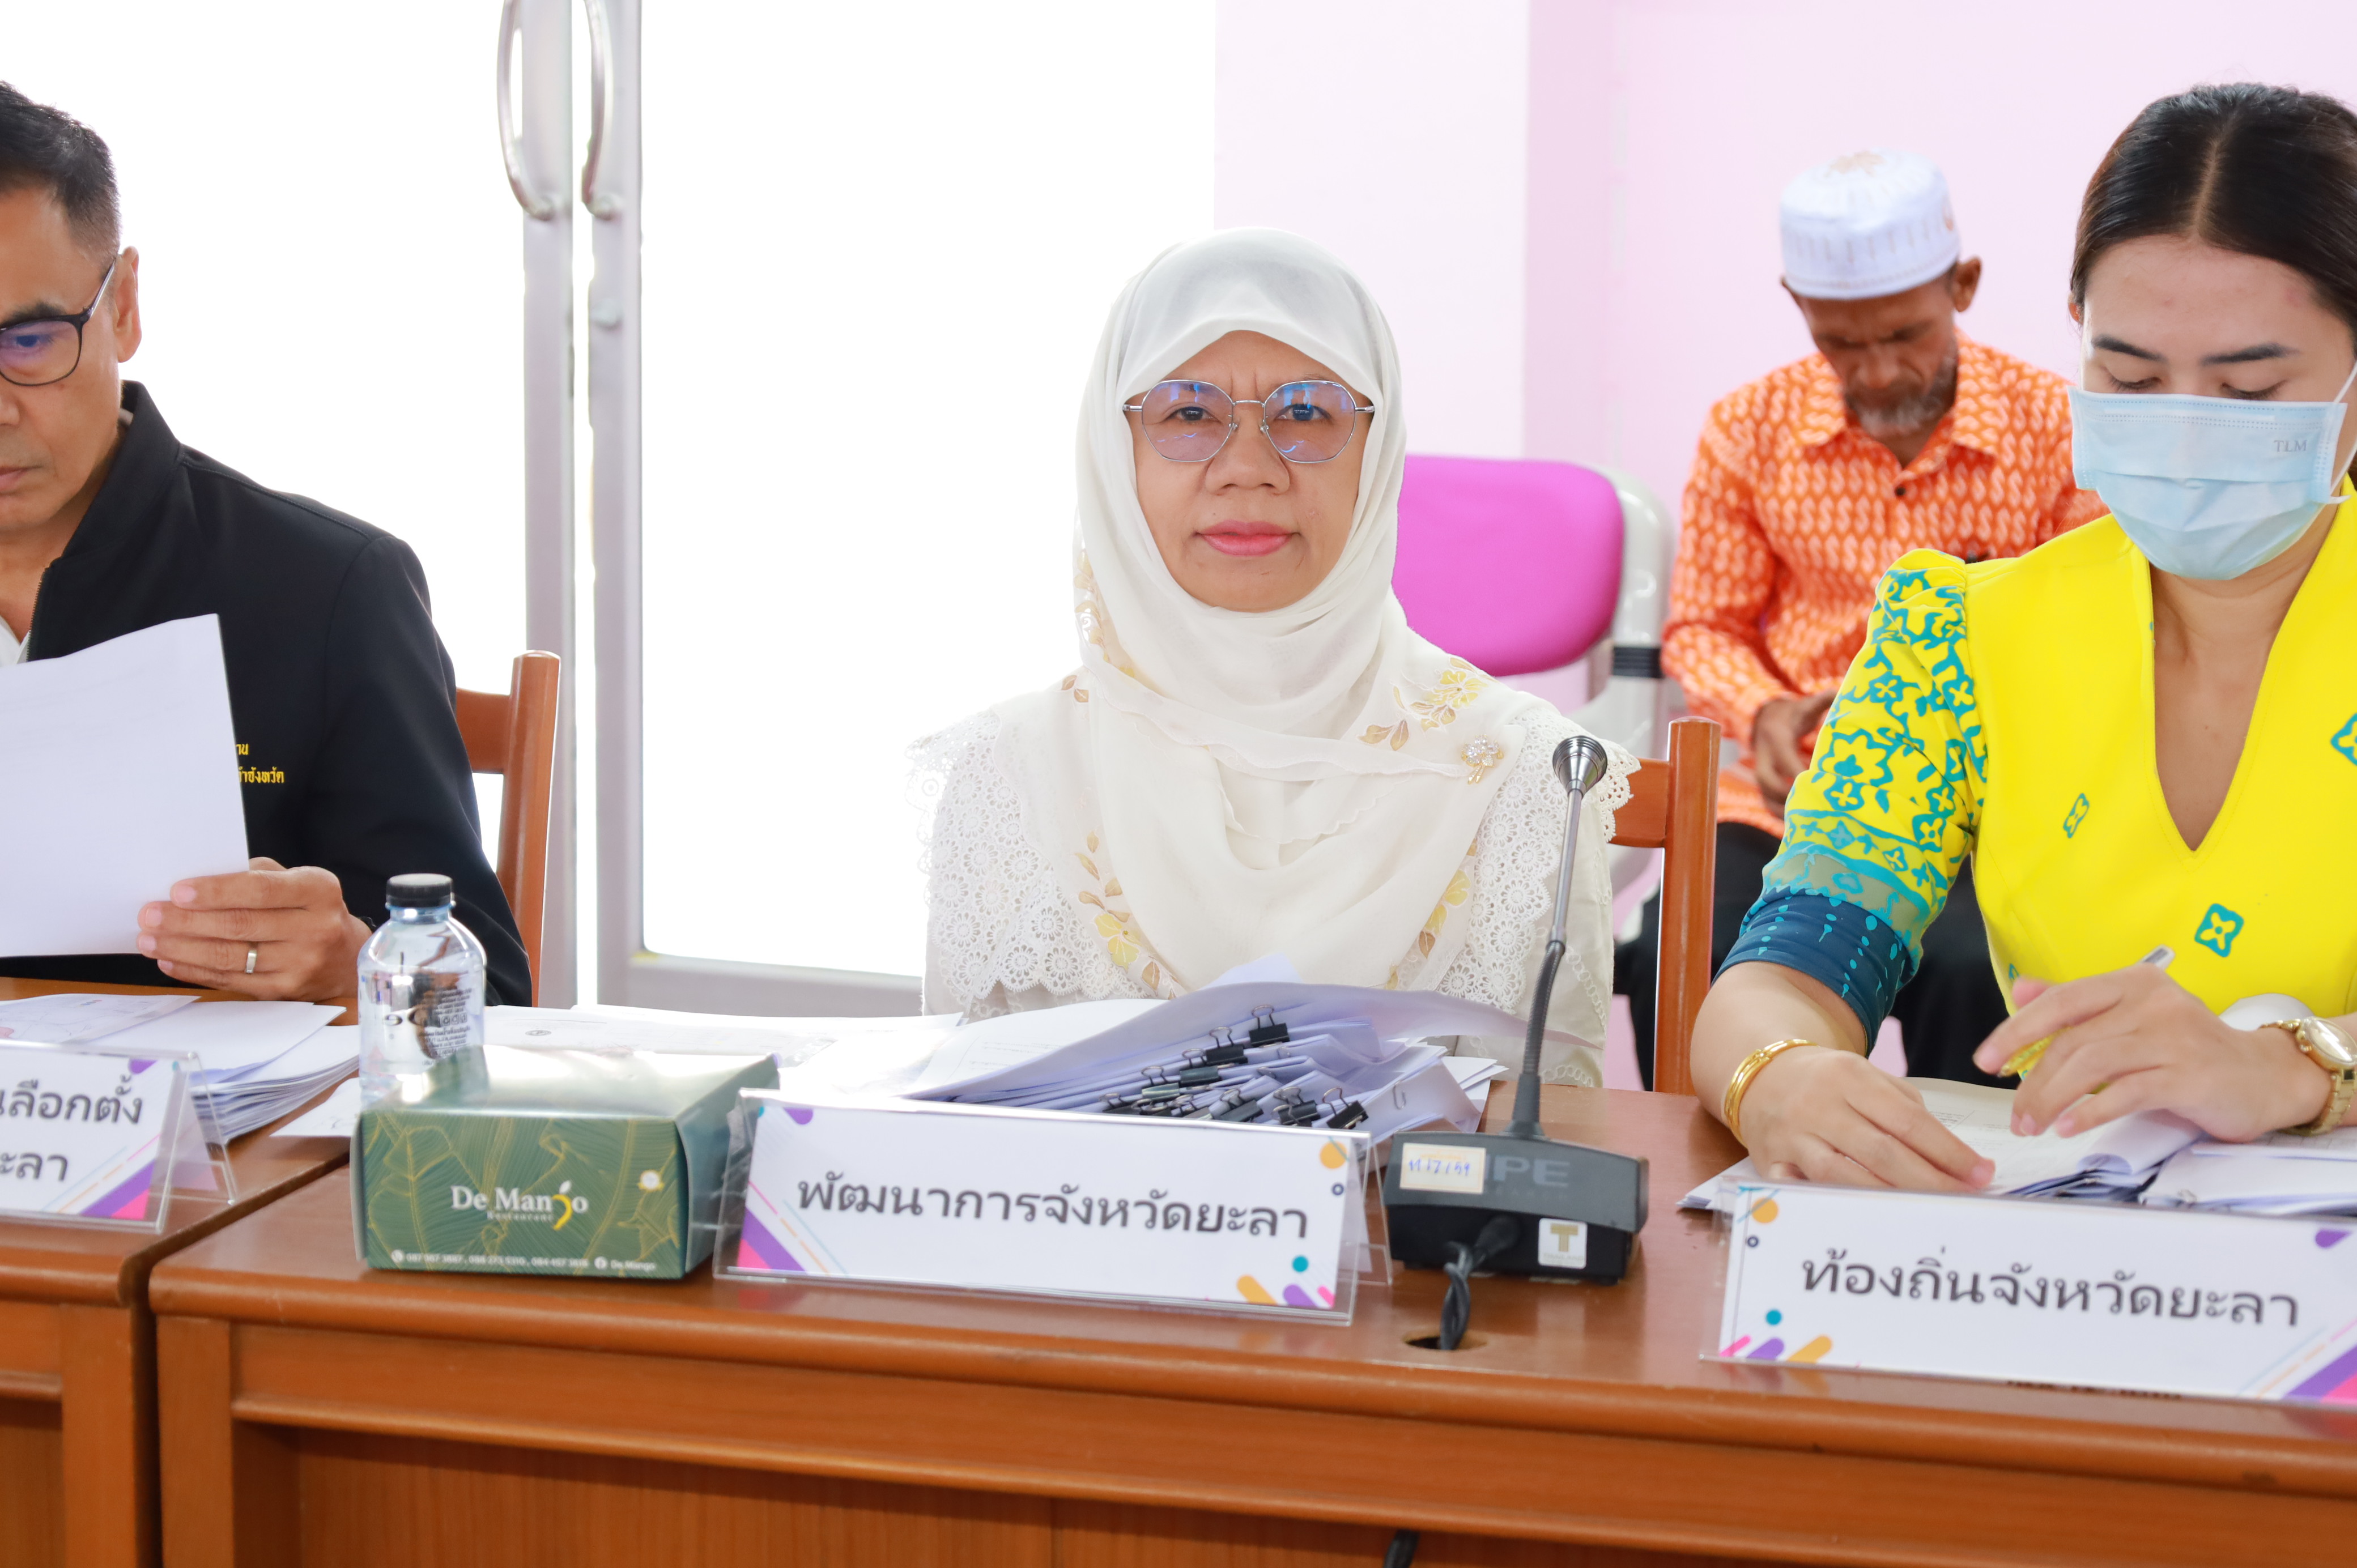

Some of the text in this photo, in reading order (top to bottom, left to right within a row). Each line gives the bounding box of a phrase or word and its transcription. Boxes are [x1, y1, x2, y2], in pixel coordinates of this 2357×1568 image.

[2274, 440, 2308, 453] TLM
[1485, 1153, 1570, 1187] PE
[451, 1185, 487, 1211] De
[798, 1171, 1308, 1238] พัฒนาการจังหวัดยะลา
[1550, 1224, 1579, 1252] T
[1802, 1248, 2299, 1326] ท้องถิ่นจังหวัดยะลา
